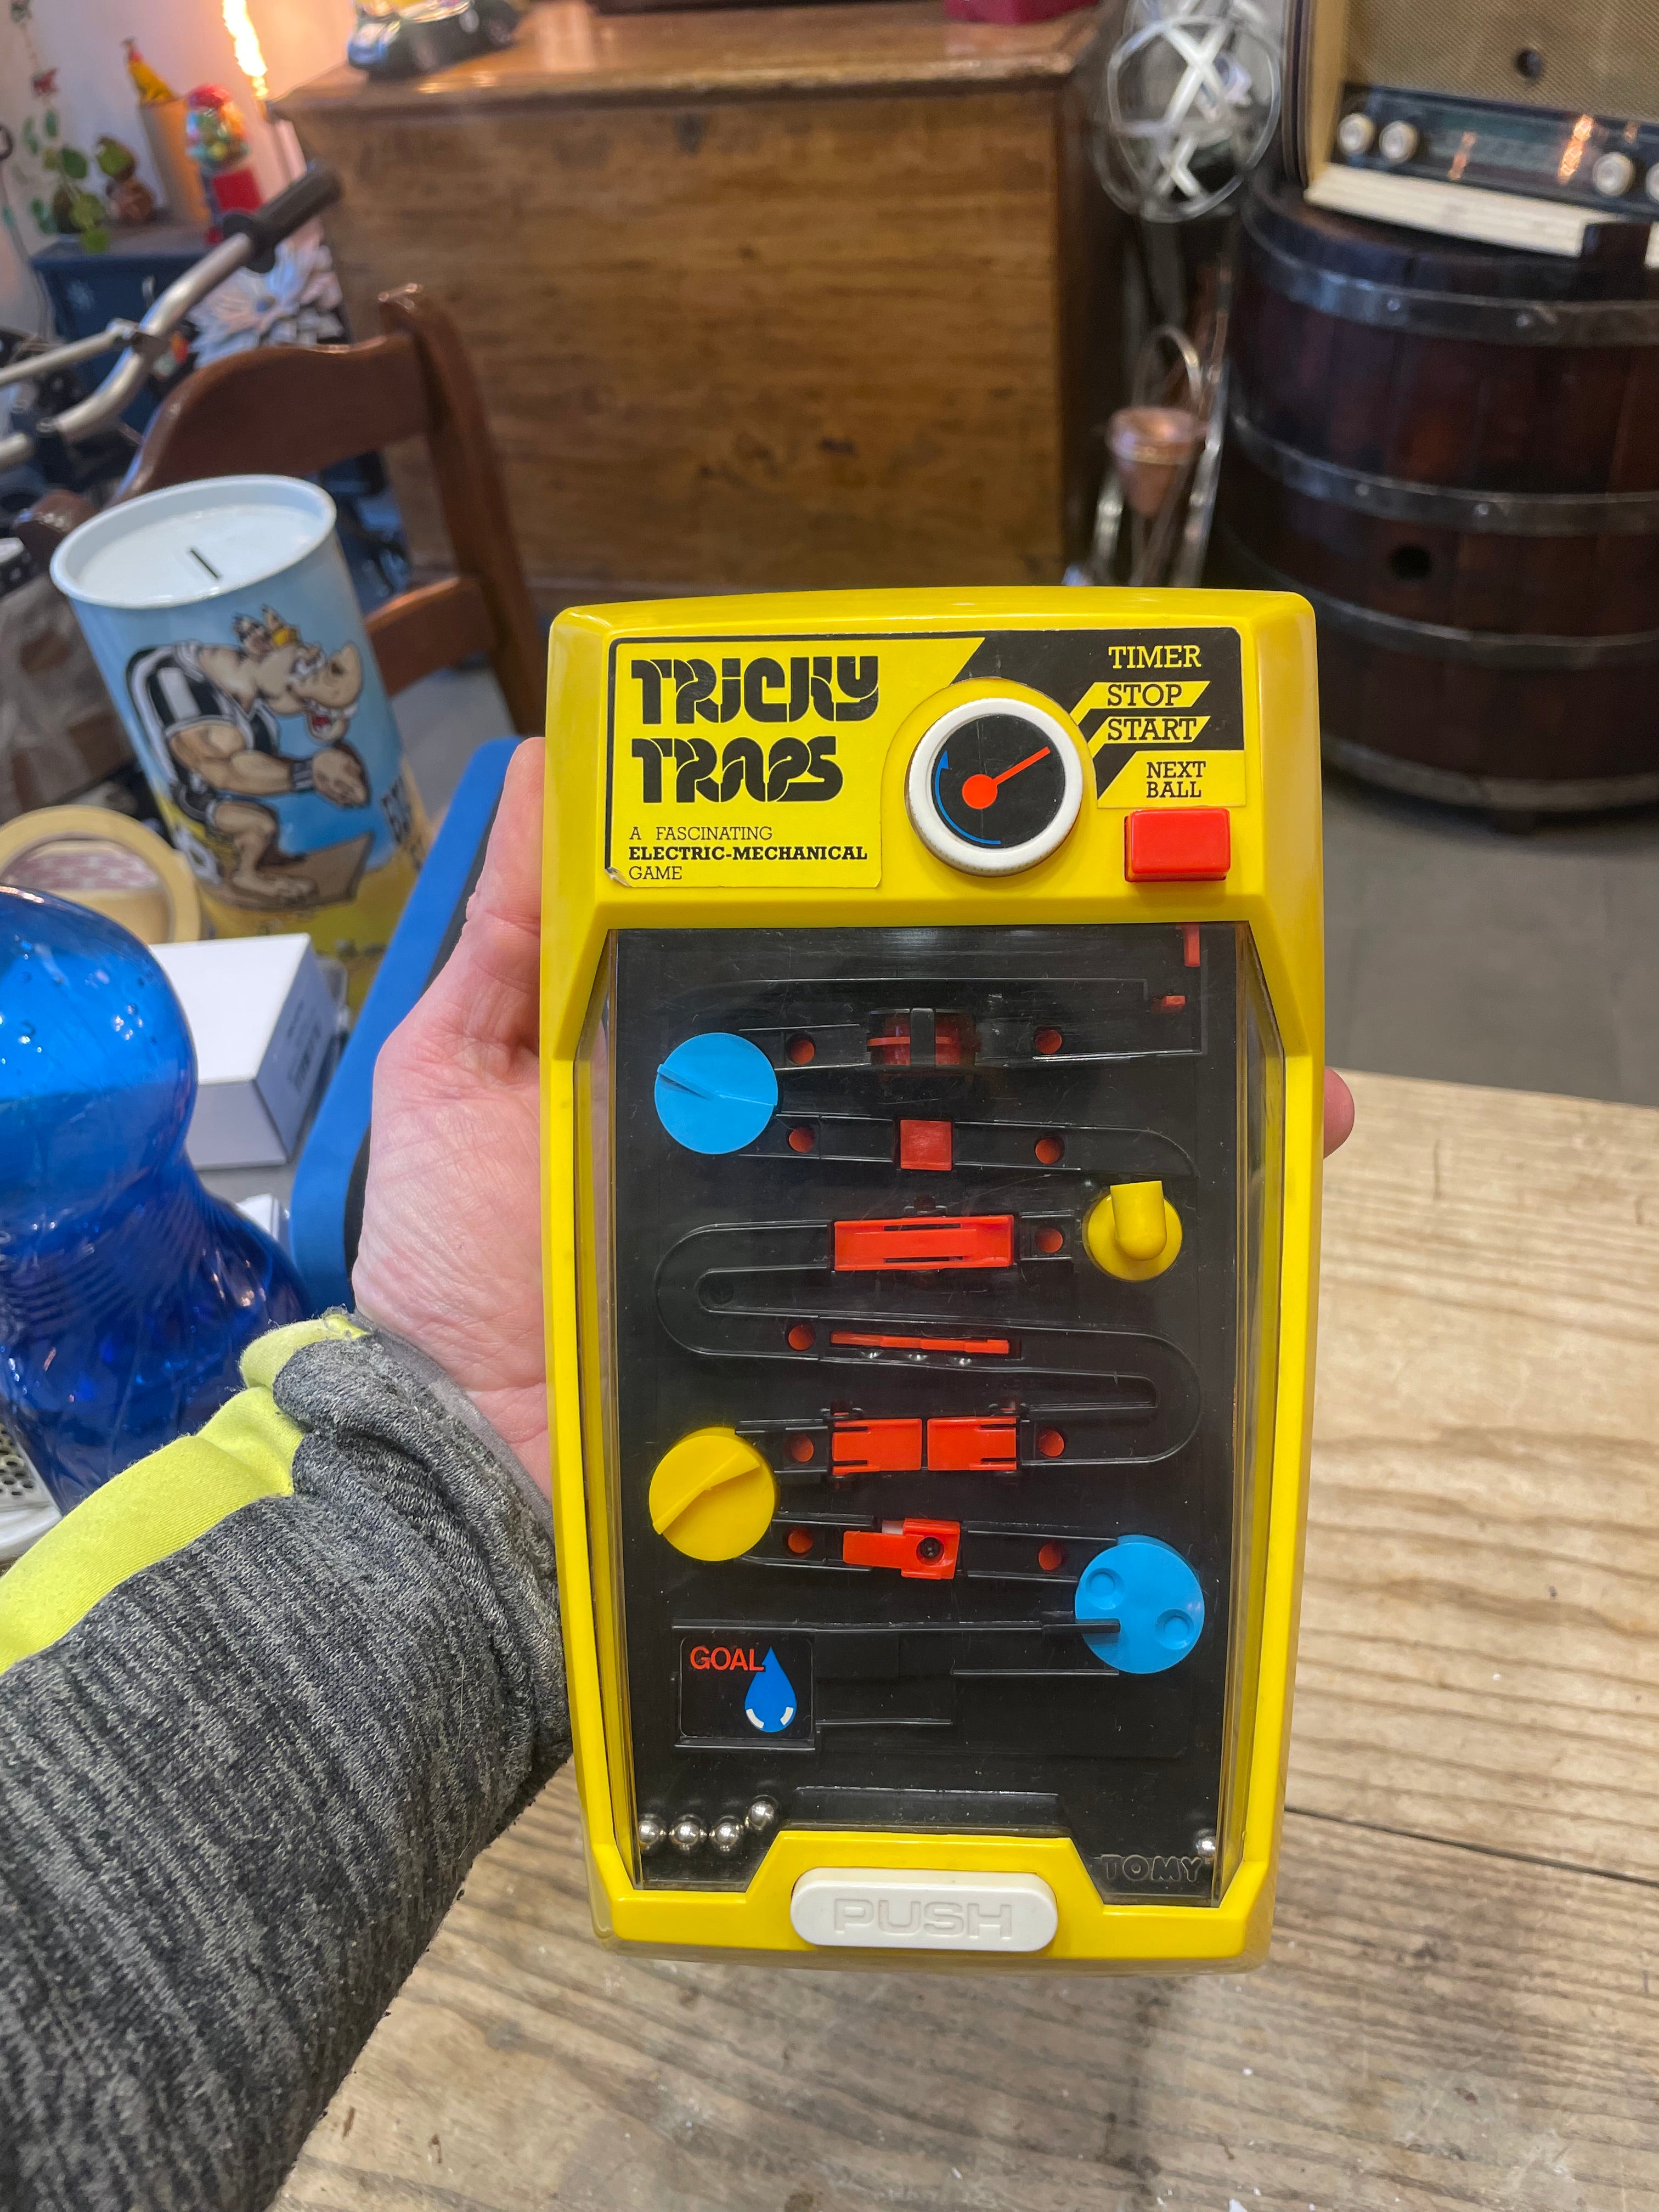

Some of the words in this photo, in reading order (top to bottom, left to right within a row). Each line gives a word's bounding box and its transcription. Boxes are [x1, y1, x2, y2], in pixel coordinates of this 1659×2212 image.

[1108, 644, 1202, 669] TIMER
[1107, 683, 1182, 707] STOP
[1107, 717, 1197, 741] START
[631, 735, 844, 804] TRAPS
[1146, 760, 1206, 779] NEXT
[1146, 781, 1203, 798] BALL
[629, 826, 642, 841] A
[655, 826, 773, 841] FASCINATING
[628, 845, 868, 861] ELECTRIC-MECHANICAL
[628, 865, 682, 881] GAME
[690, 1645, 765, 1672] GOAL
[1100, 1853, 1203, 1882] TOMY
[833, 1897, 1013, 1940] PUSH
